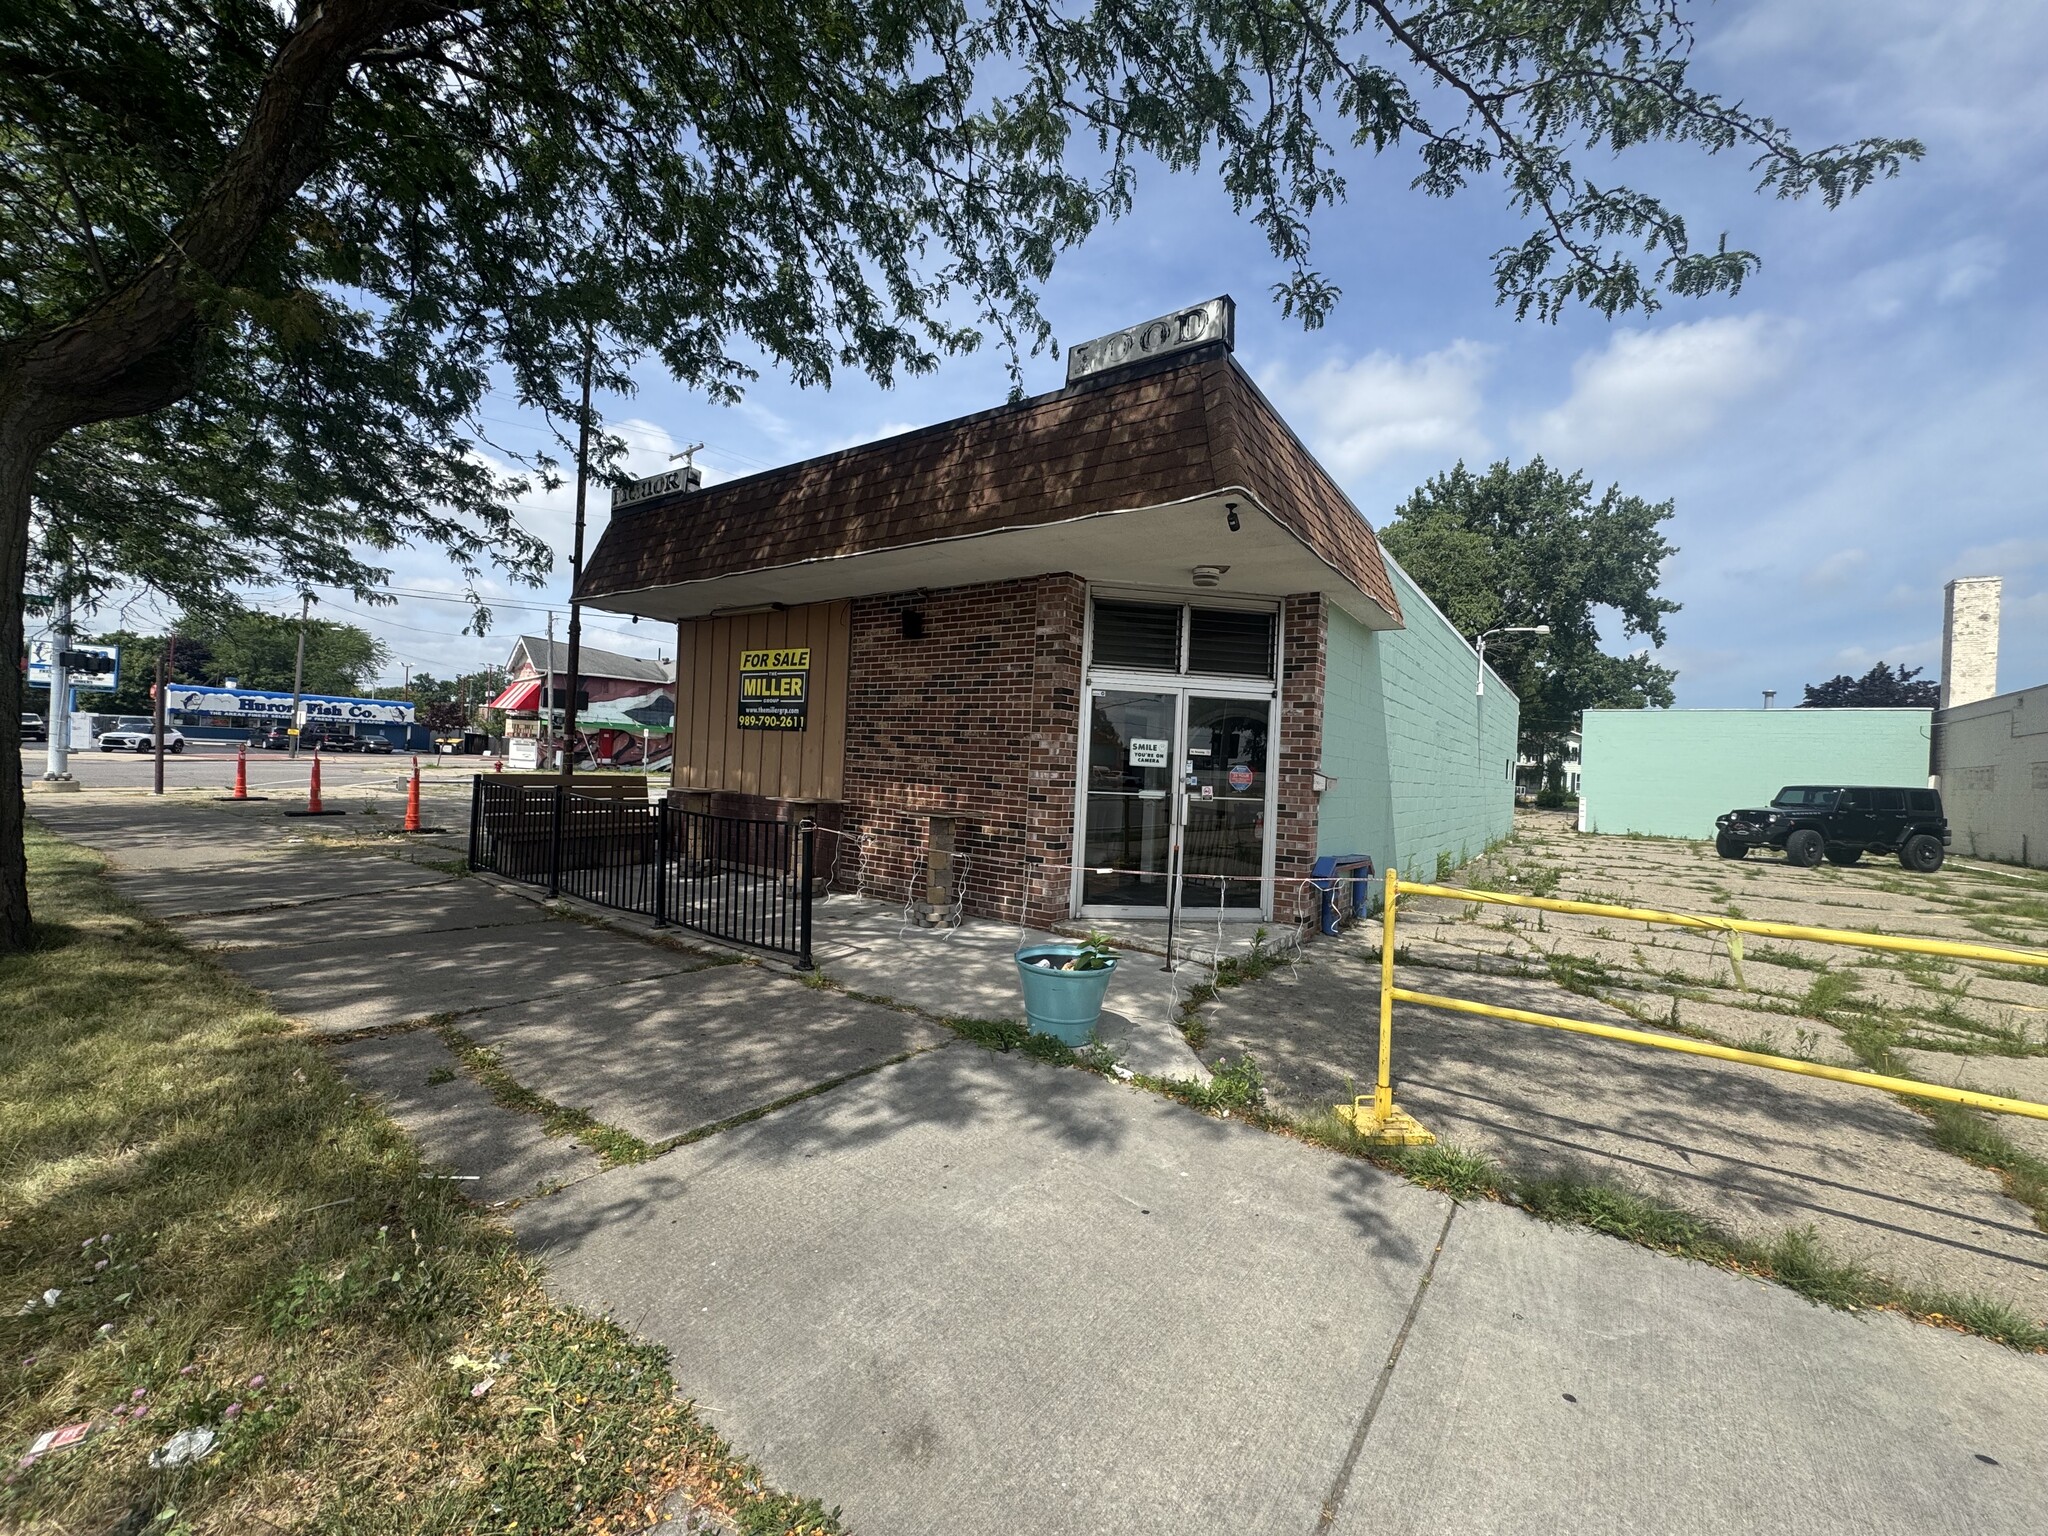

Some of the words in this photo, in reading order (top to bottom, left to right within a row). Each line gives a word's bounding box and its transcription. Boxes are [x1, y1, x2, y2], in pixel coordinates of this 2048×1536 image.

[743, 653, 769, 668] FOR
[772, 651, 808, 667] SALE
[743, 677, 802, 696] MILLER
[238, 698, 294, 714] Huron
[306, 703, 342, 716] Fish
[348, 706, 377, 718] Co.
[738, 715, 804, 727] 989-790-2611
[1132, 743, 1158, 751] SMILE
